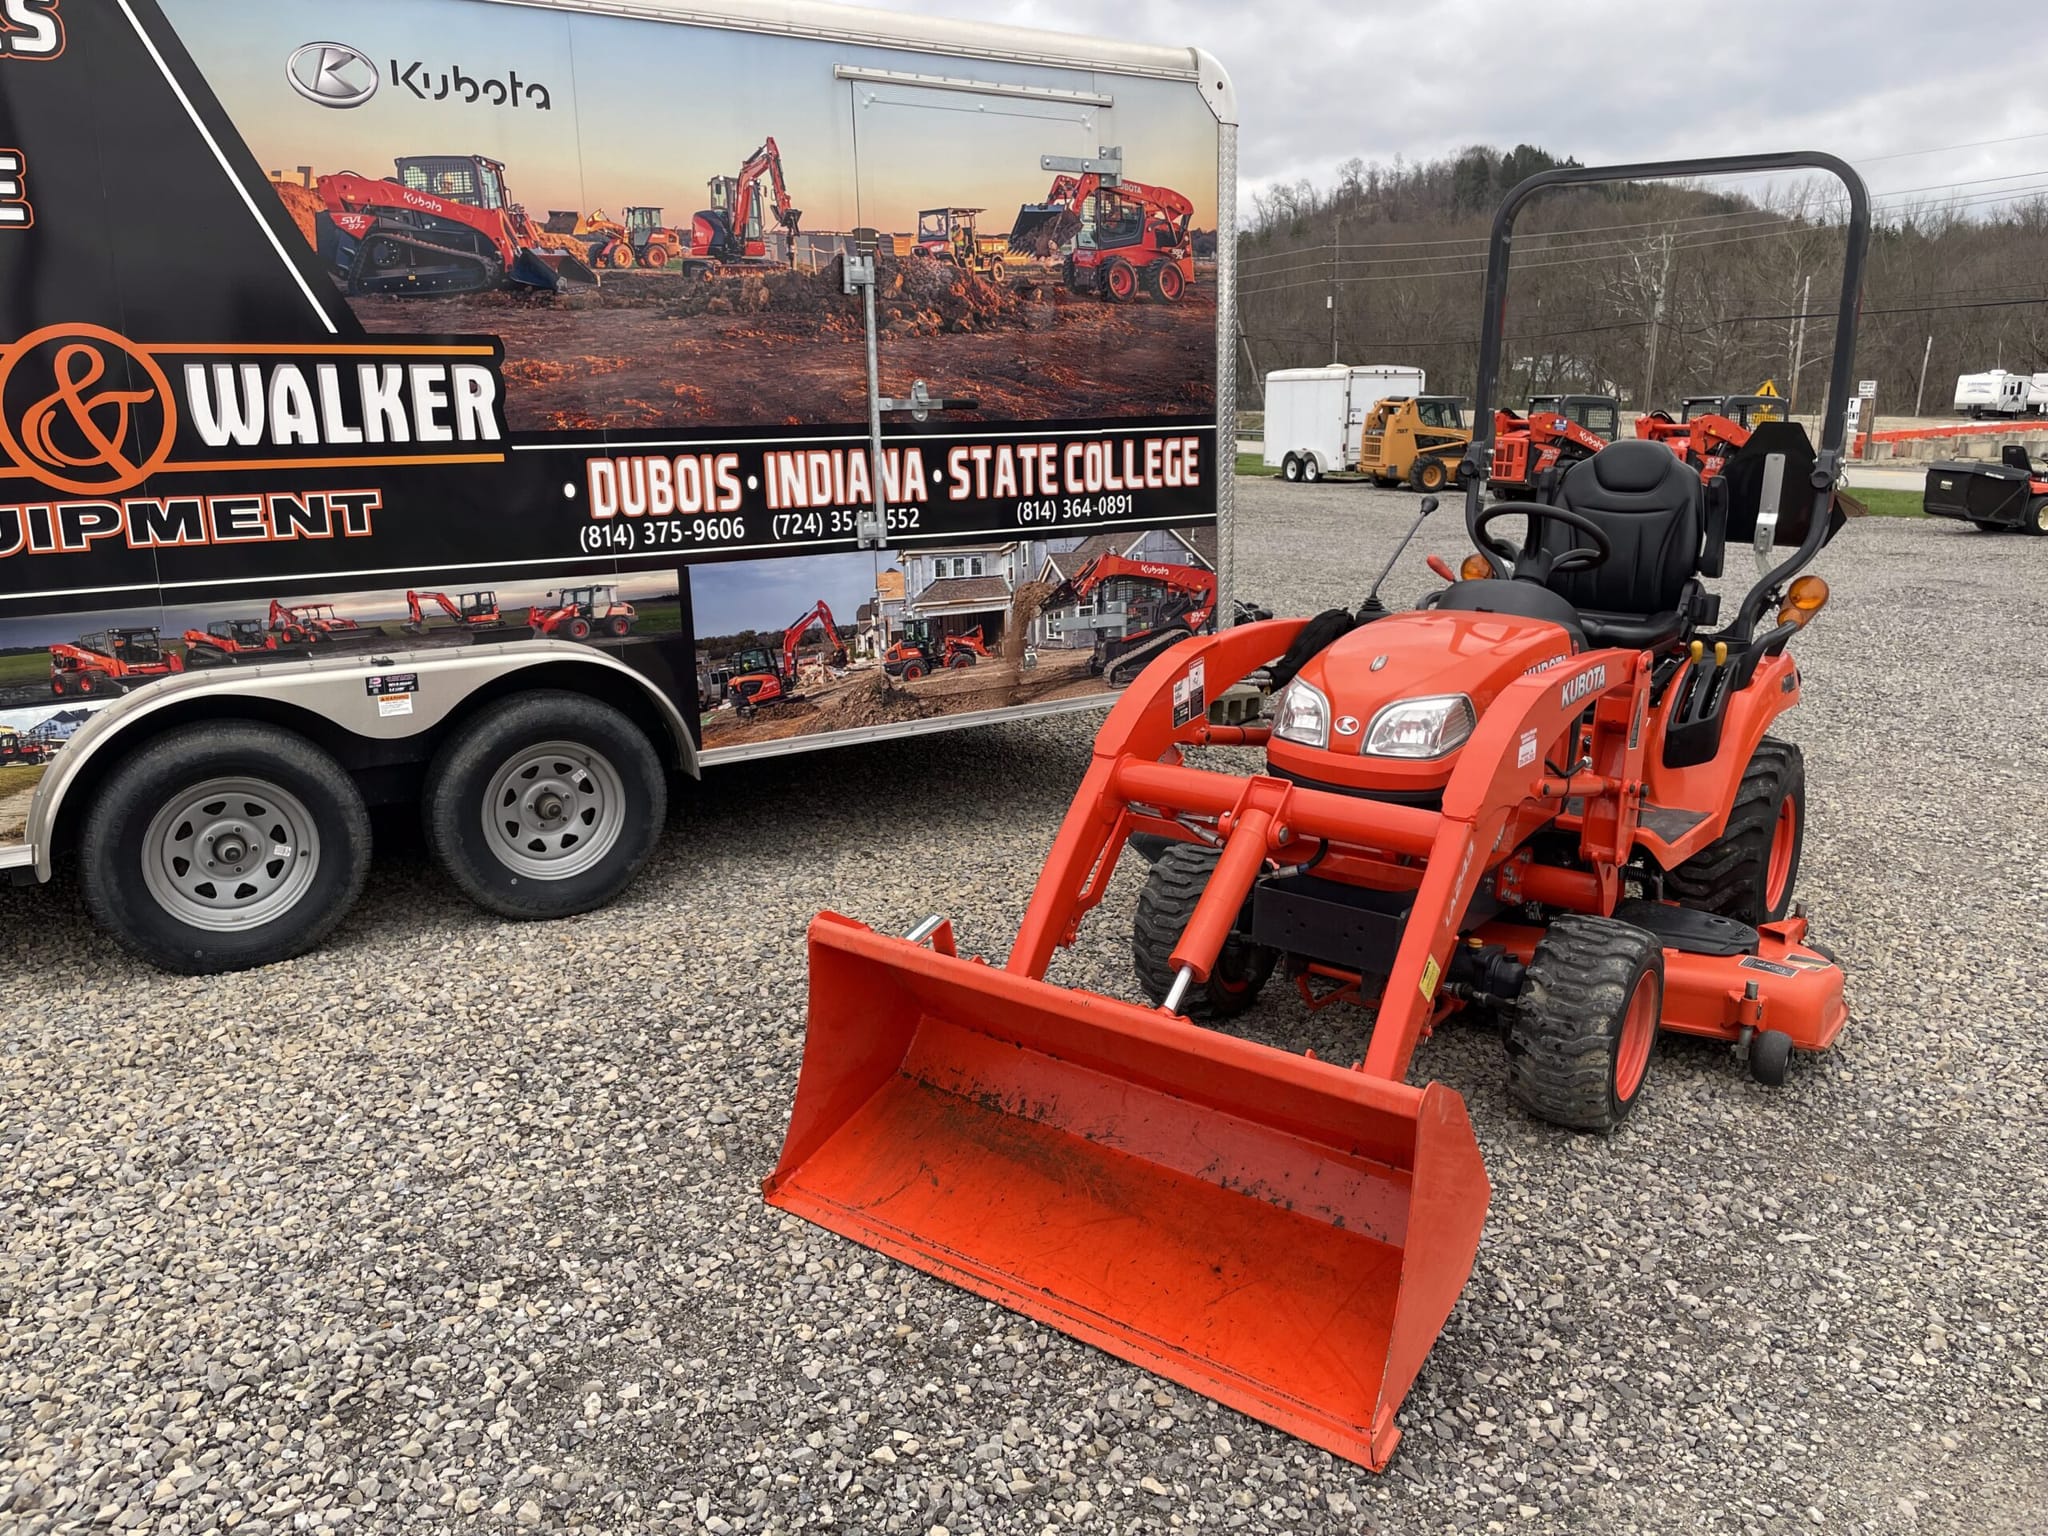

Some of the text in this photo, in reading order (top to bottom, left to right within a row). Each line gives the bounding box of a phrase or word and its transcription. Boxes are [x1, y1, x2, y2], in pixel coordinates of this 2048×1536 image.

[390, 59, 551, 110] Kubota
[403, 192, 442, 212] Kubota
[340, 216, 366, 225] SVL
[21, 344, 501, 470] & WALKER
[1579, 430, 1604, 450] Kubota
[586, 436, 1199, 519] DUBOIS INDIANA STATE COLLEGE
[1017, 494, 1133, 525] (814) 364-0891
[580, 517, 745, 552] (814) 375-9606
[772, 512, 823, 540] (724)
[1141, 564, 1169, 576] Kubota
[1561, 664, 1606, 711] KUBOTA
